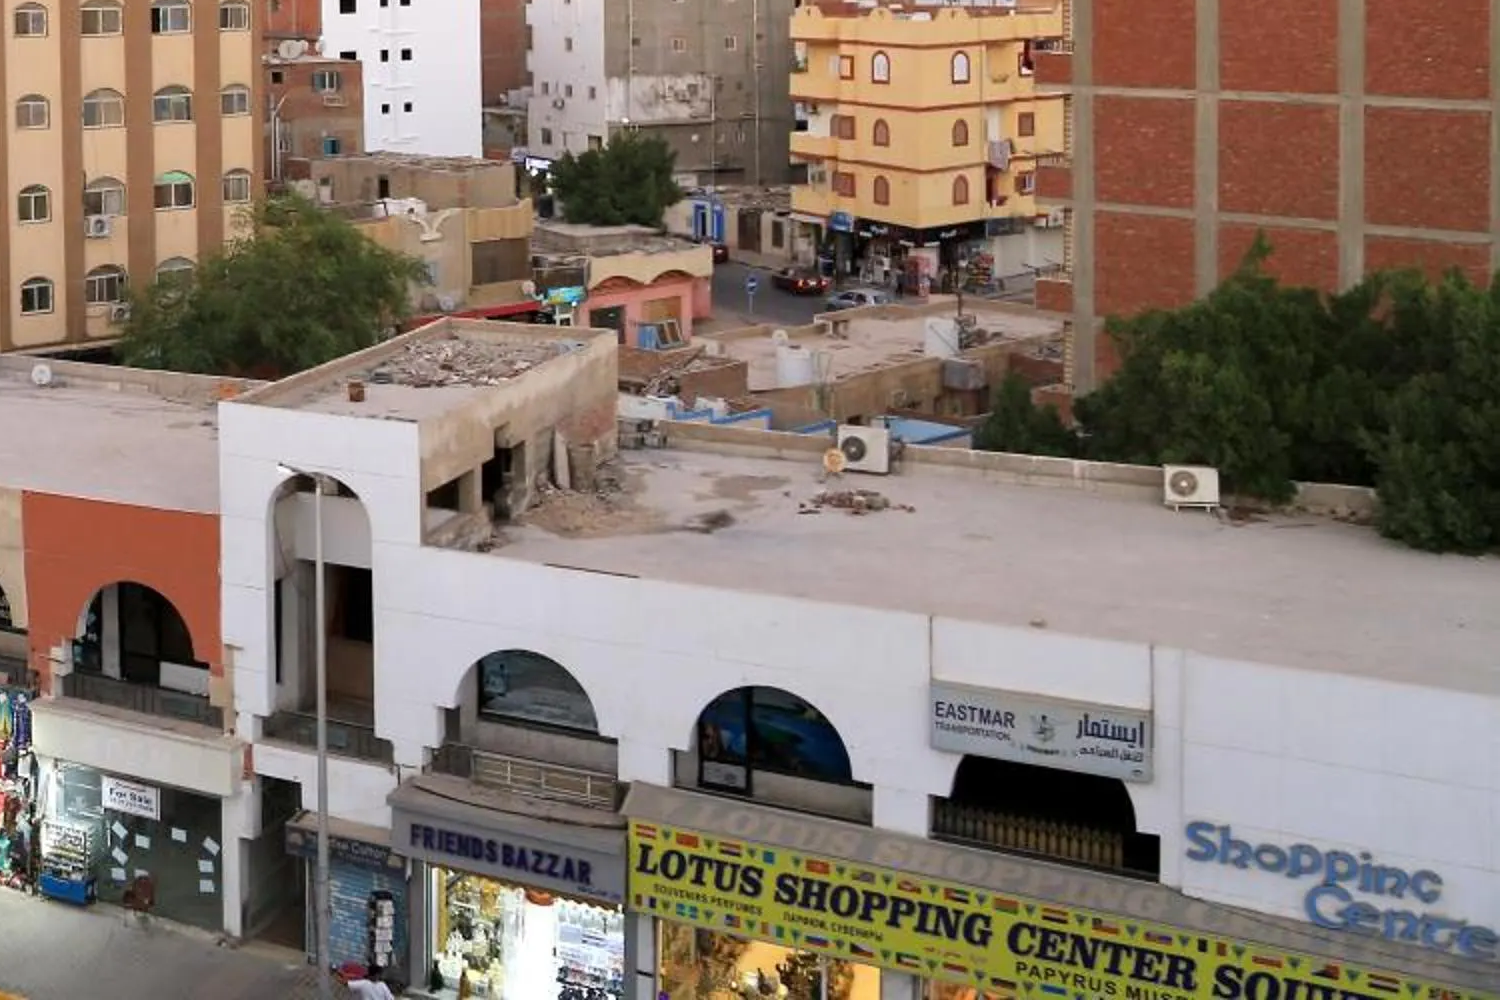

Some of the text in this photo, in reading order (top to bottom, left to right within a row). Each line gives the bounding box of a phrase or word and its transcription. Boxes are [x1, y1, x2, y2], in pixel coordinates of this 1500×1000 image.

[934, 701, 1015, 729] EASTMAR
[934, 721, 1011, 742] TRANSPORTATION
[410, 823, 592, 886] FRIENDS BAZZAR
[1185, 820, 1445, 904] Shopping
[636, 842, 765, 898] LOTUS
[773, 871, 994, 950] SHOPPING
[1006, 921, 1198, 992] CENTER
[1015, 961, 1117, 995] PAPYRUS
